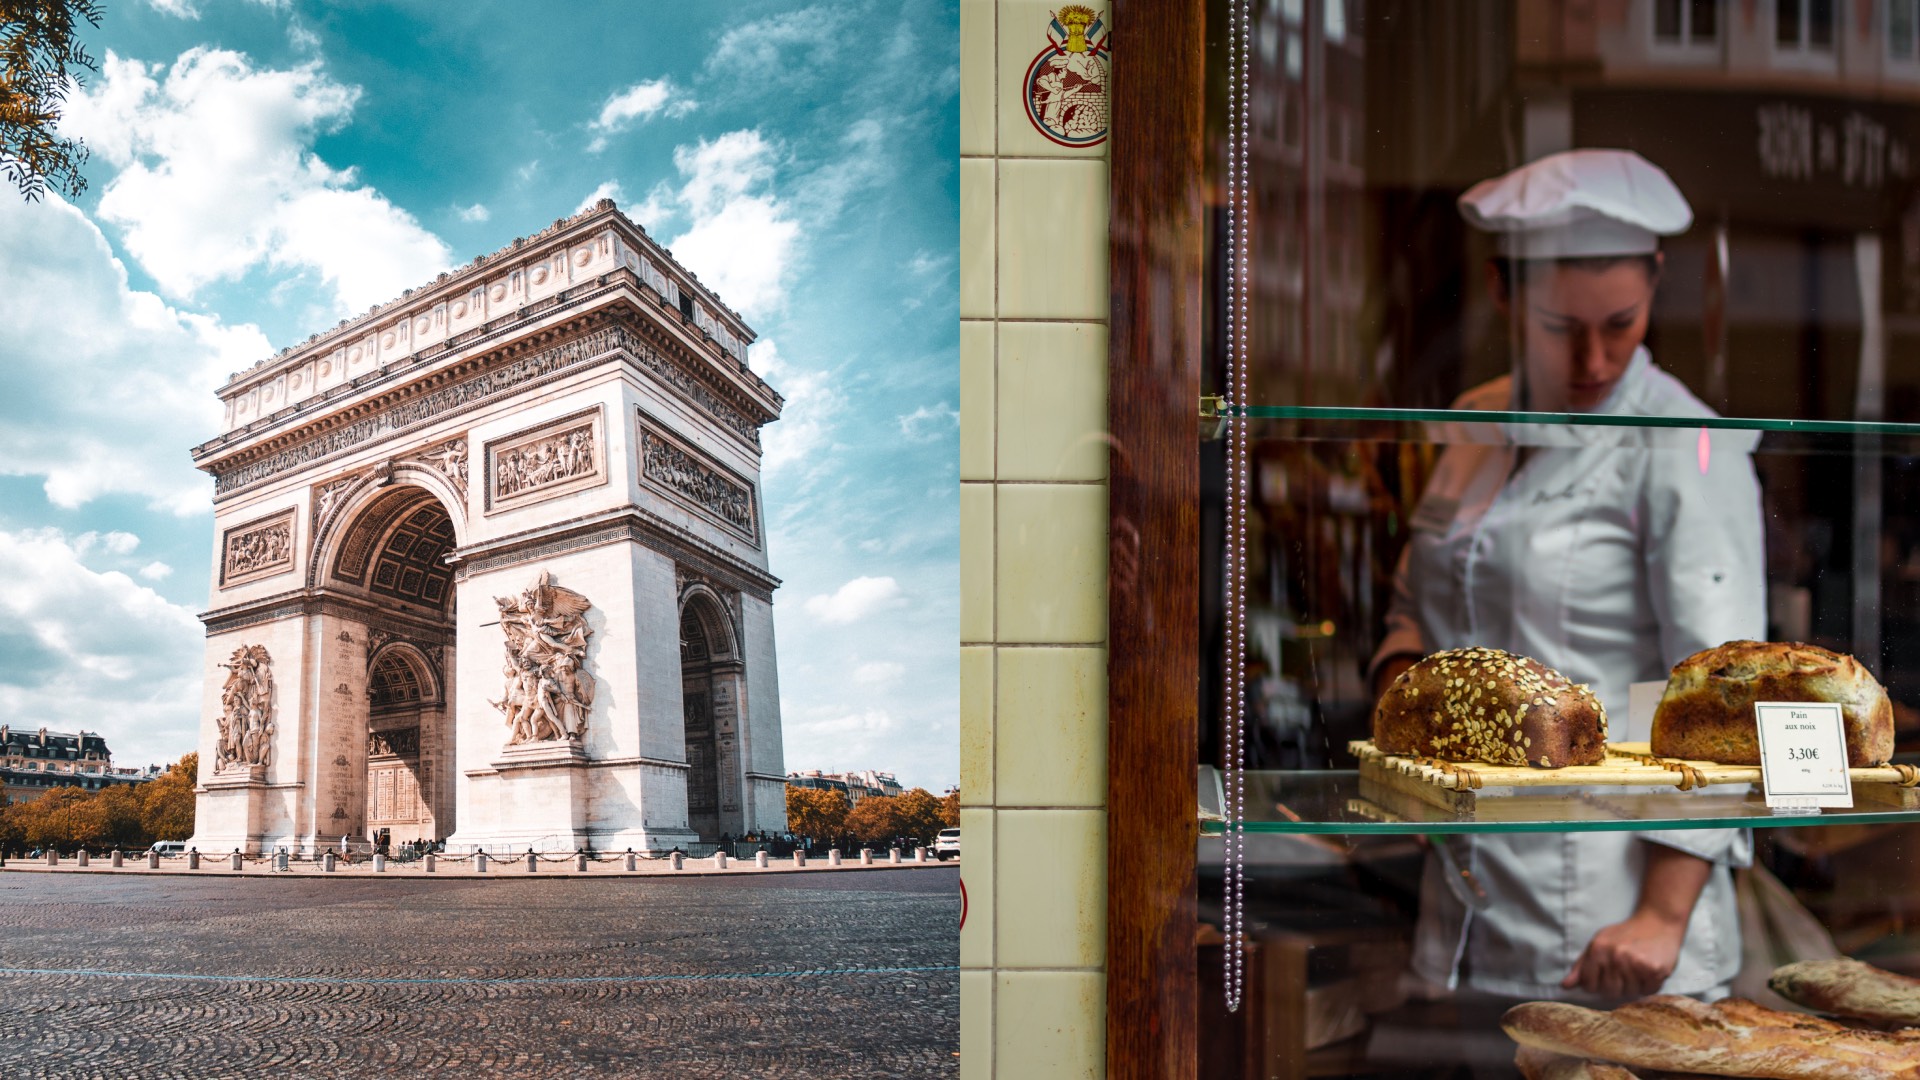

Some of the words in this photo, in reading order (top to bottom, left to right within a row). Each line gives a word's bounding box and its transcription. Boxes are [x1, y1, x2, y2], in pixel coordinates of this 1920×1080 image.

[1790, 711, 1808, 719] Pain
[1800, 722, 1816, 730] noix
[1788, 747, 1820, 762] 3,30€
